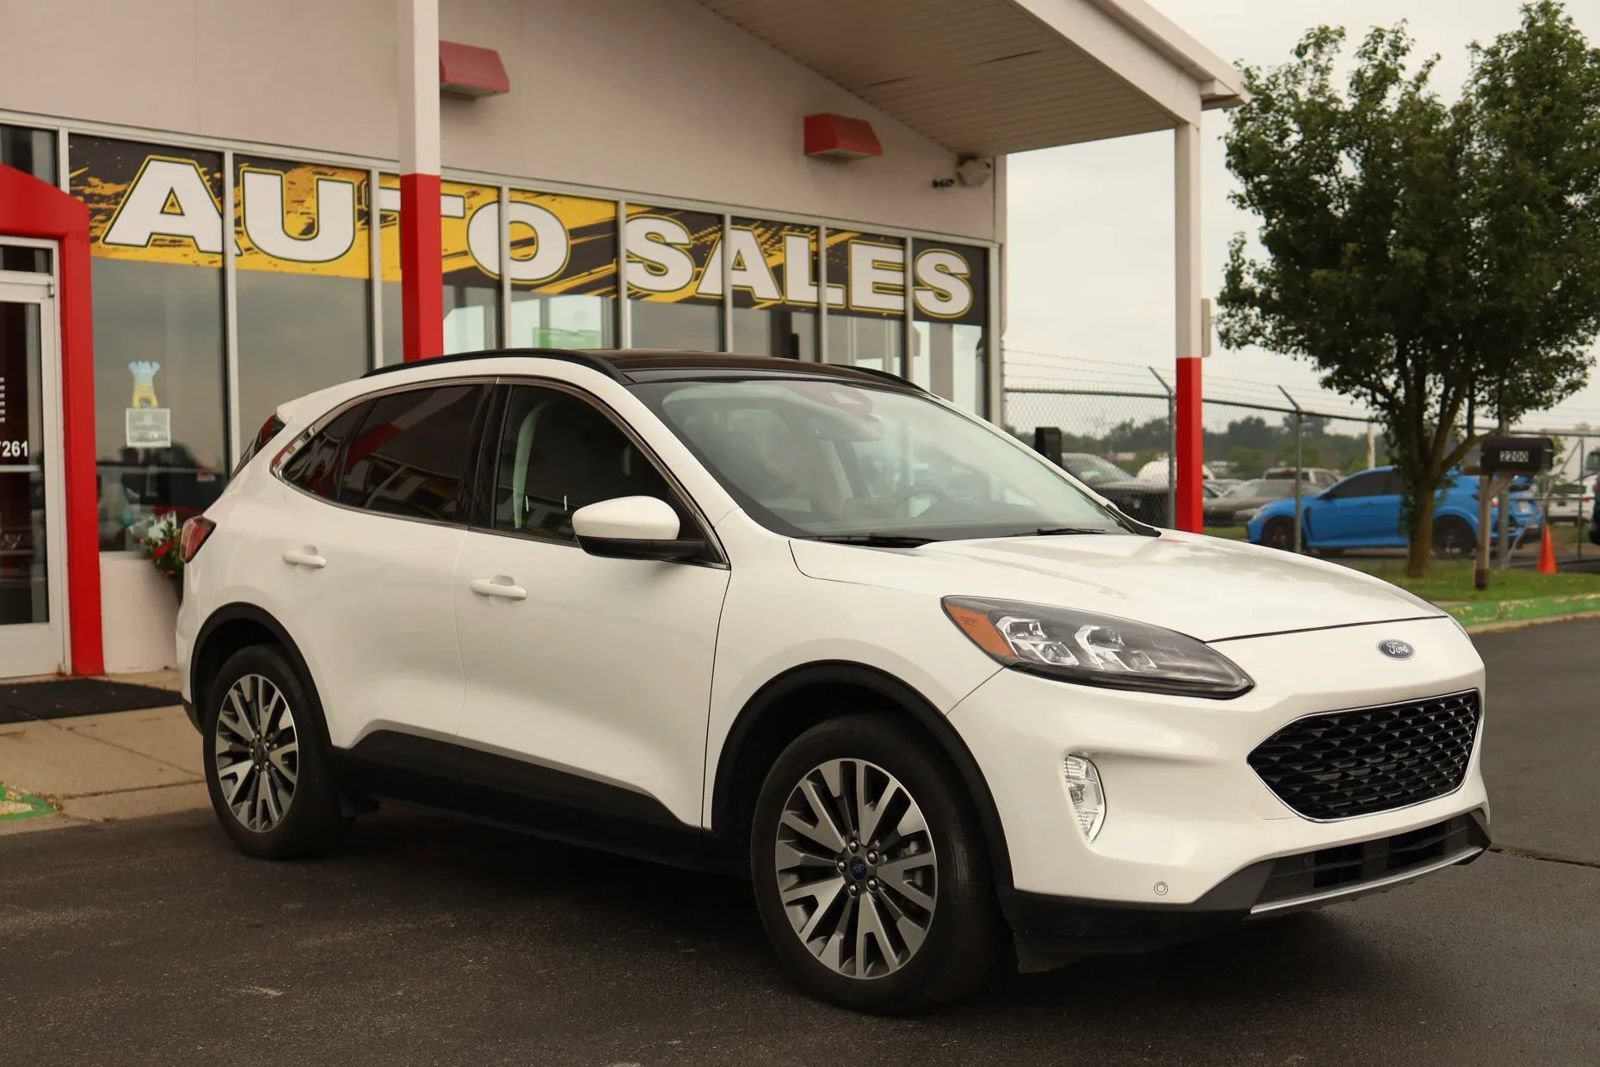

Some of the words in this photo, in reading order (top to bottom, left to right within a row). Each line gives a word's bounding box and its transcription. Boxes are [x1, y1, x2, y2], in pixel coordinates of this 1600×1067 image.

[624, 215, 974, 318] SALES
[0, 440, 28, 457] 261
[1386, 642, 1409, 655] Ford
